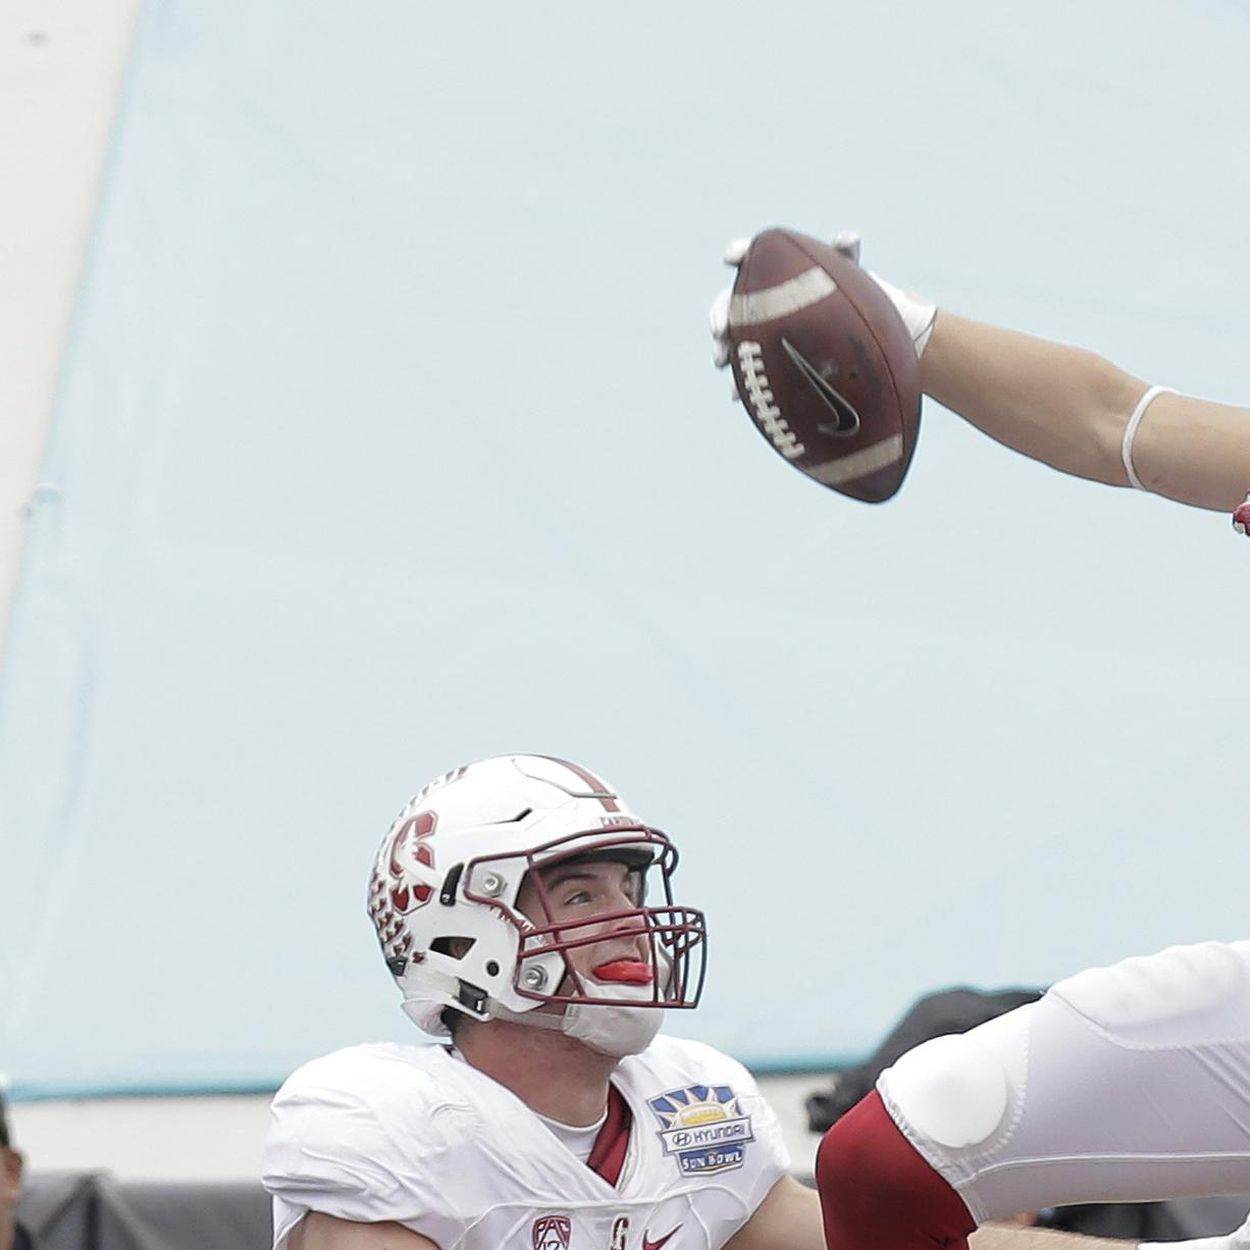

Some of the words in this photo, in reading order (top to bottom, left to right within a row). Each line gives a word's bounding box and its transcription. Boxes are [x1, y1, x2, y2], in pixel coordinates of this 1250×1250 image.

[693, 1123, 746, 1143] HYUNDAI
[682, 1157, 706, 1171] SUN
[707, 1151, 743, 1166] BOWL
